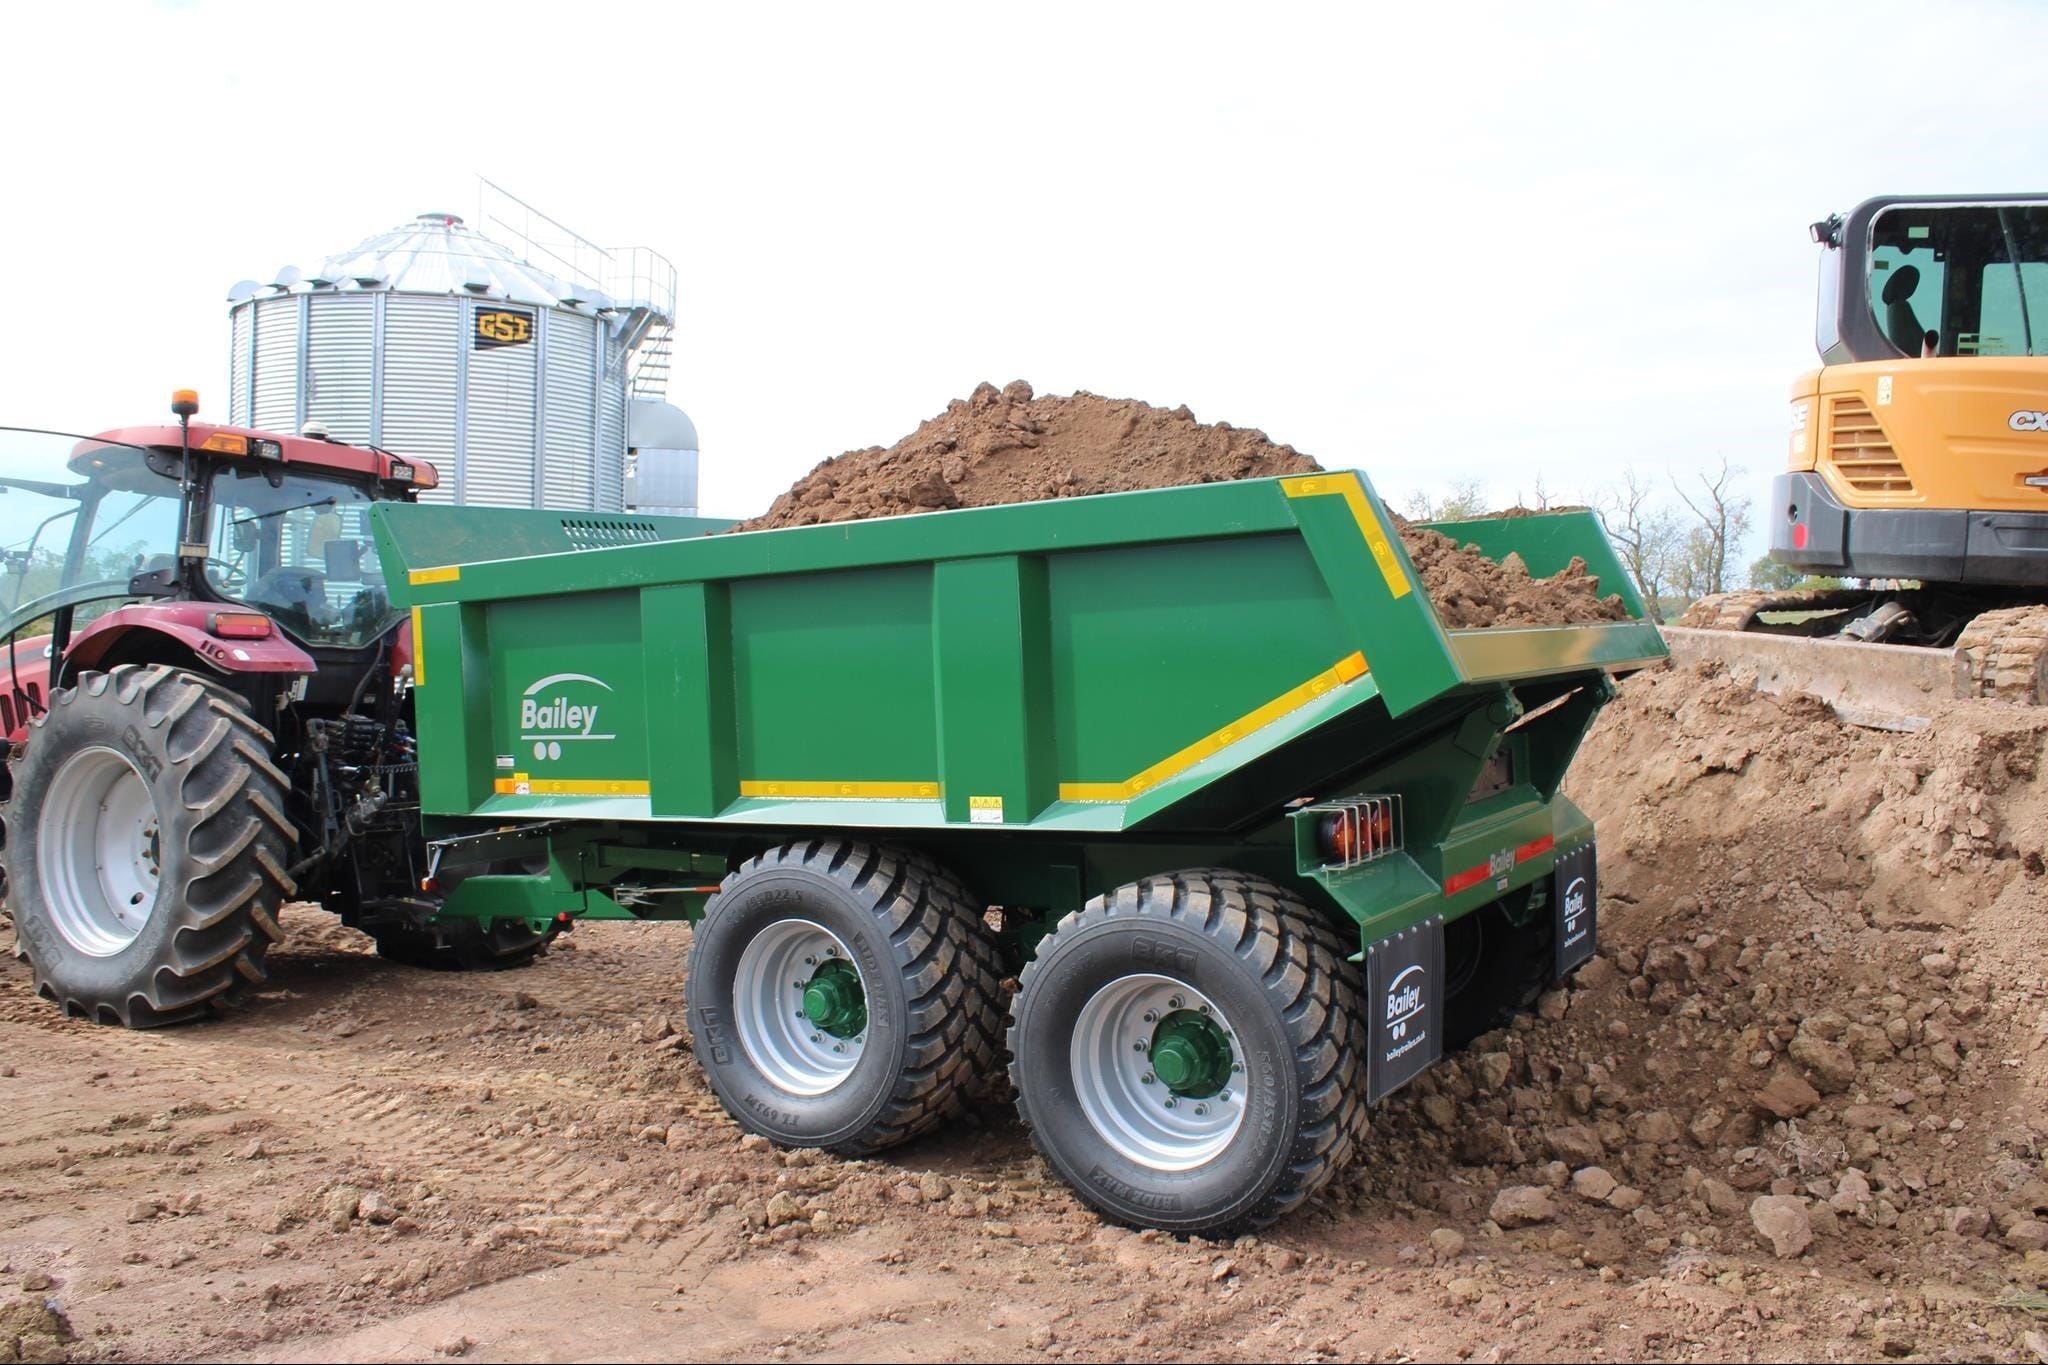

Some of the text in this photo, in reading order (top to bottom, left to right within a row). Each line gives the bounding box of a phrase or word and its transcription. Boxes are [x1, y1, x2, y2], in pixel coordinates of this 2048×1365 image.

[479, 312, 529, 342] GSI
[520, 697, 598, 736] Bailey
[1490, 847, 1515, 878] Bailey
[1564, 892, 1583, 917] Bailey
[1386, 985, 1420, 1020] Bailey
[699, 1007, 735, 1065] BKT
